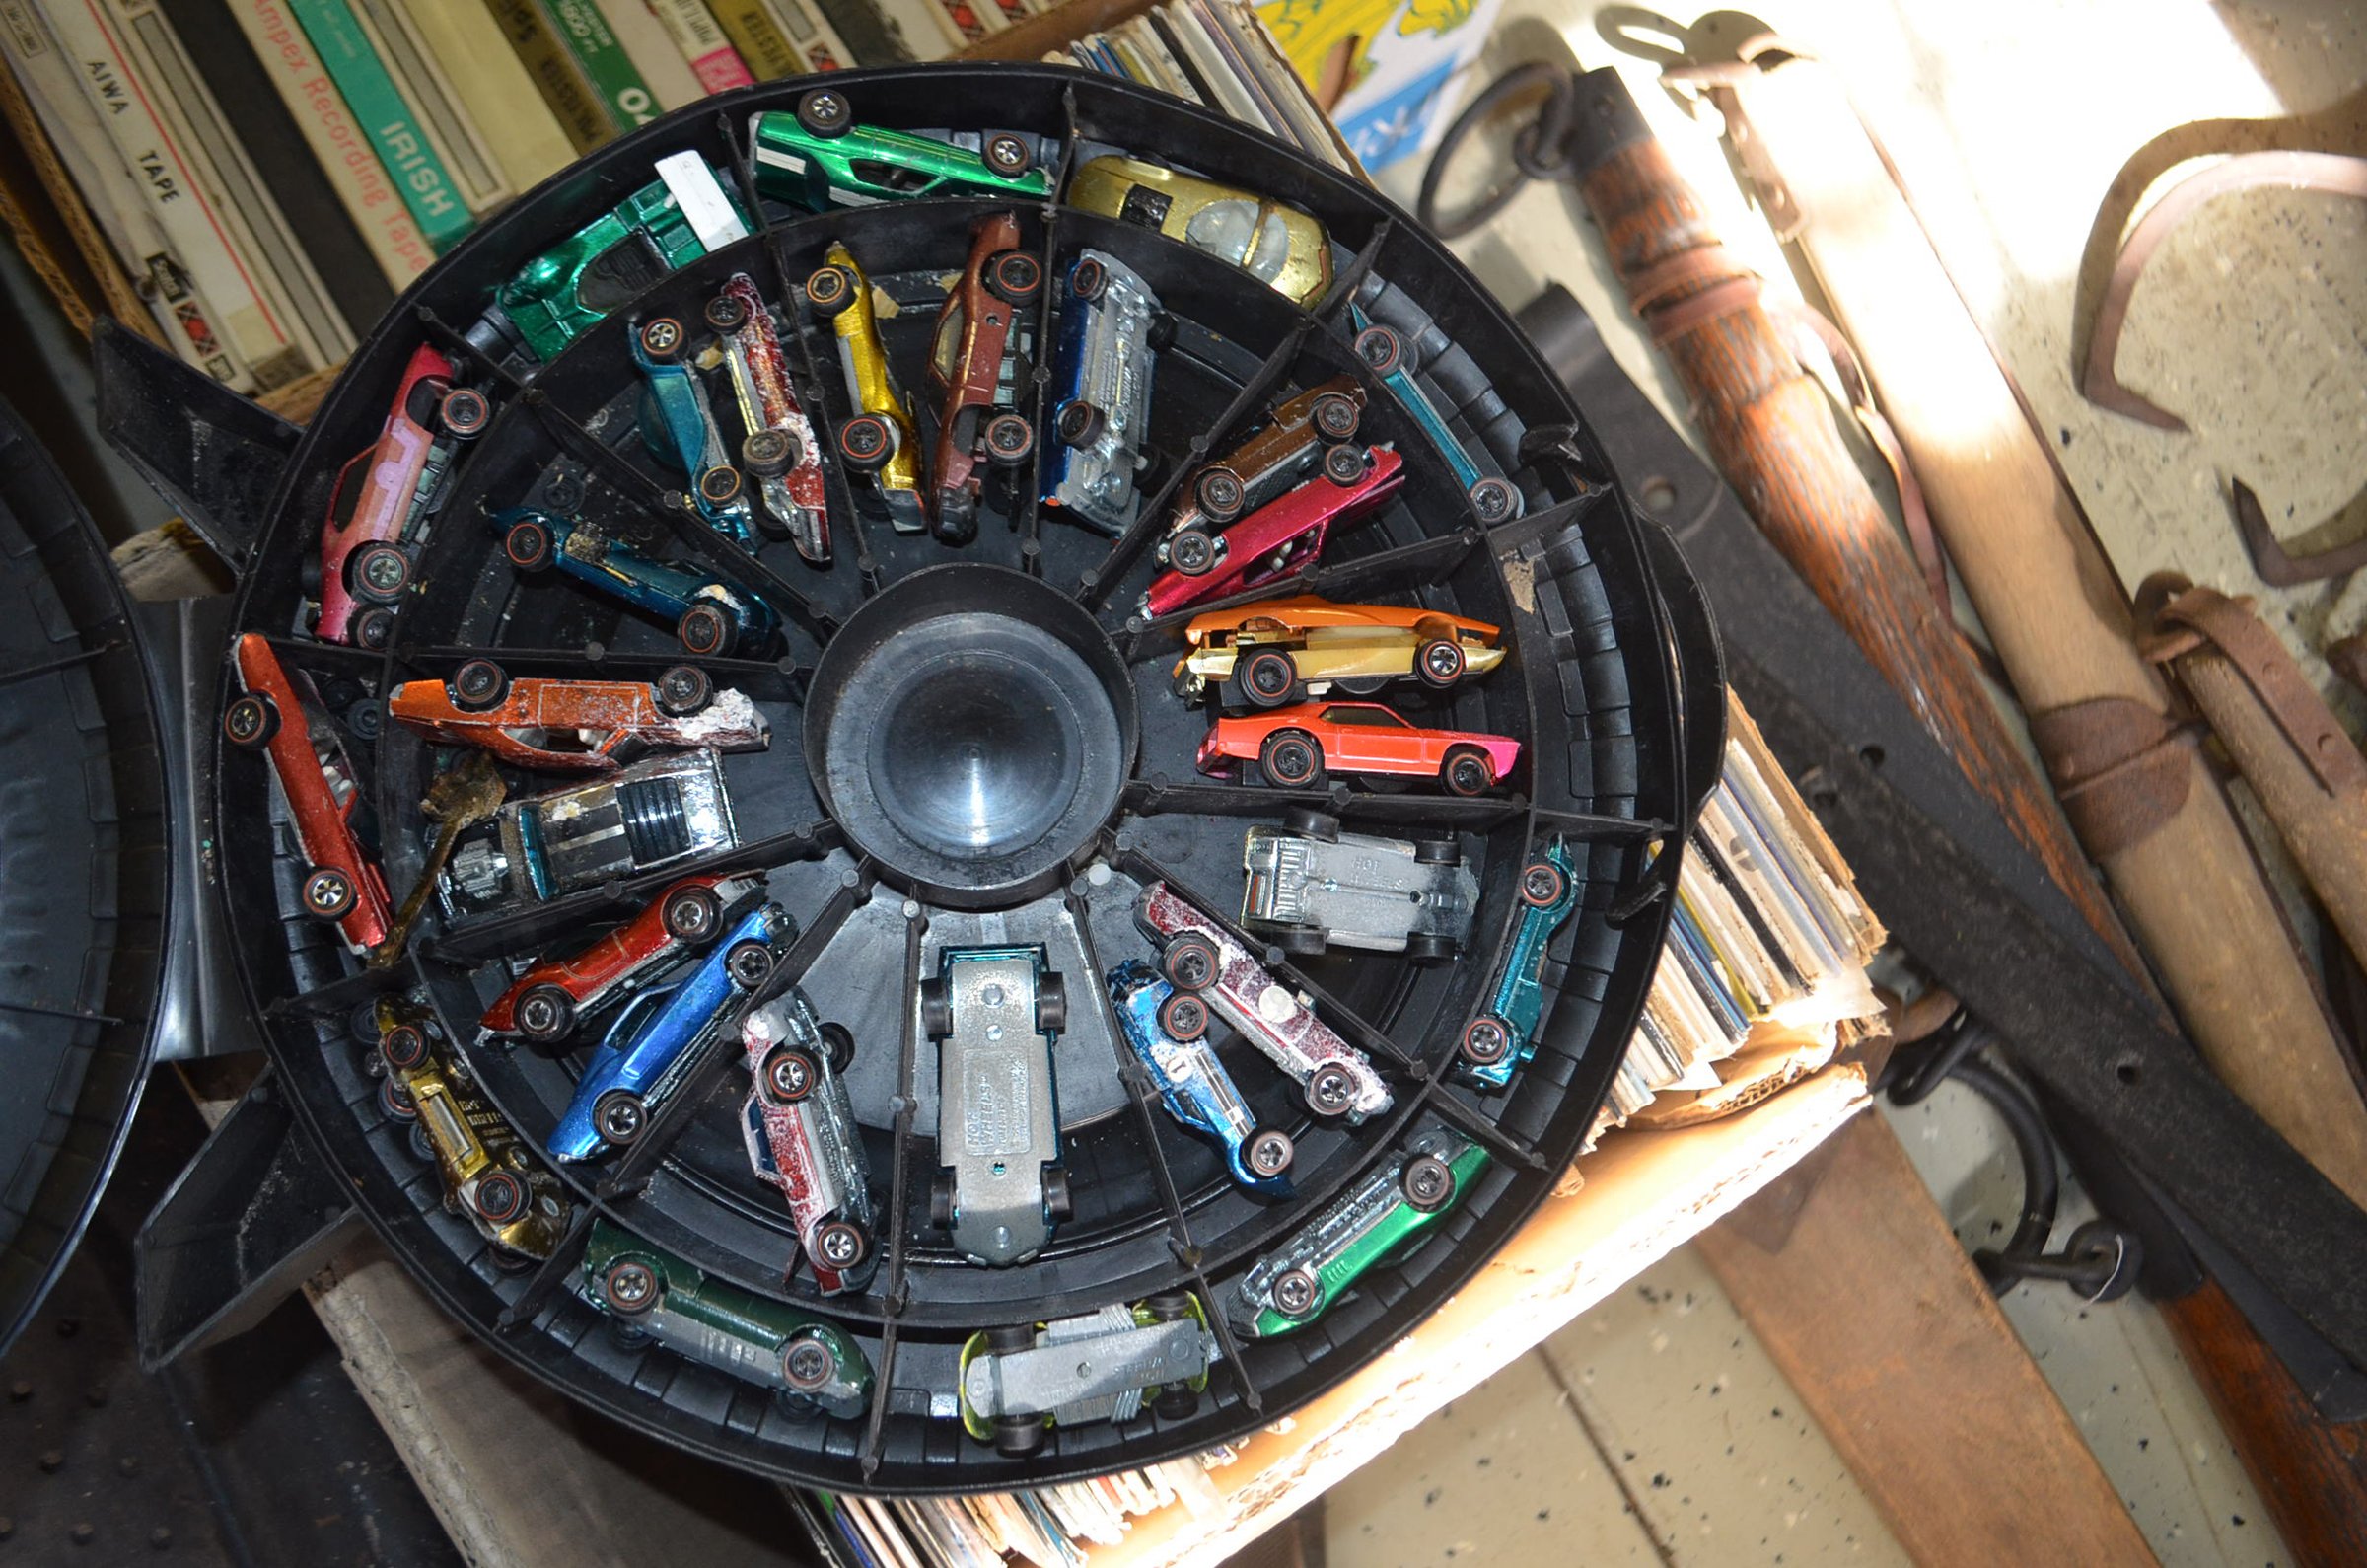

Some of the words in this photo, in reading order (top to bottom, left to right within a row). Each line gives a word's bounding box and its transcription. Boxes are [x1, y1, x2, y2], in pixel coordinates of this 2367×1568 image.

[88, 59, 129, 116] AIWA
[138, 149, 180, 204] TAPE
[302, 76, 391, 208] Recording
[383, 209, 430, 273] Tape
[380, 121, 455, 217] IRISH
